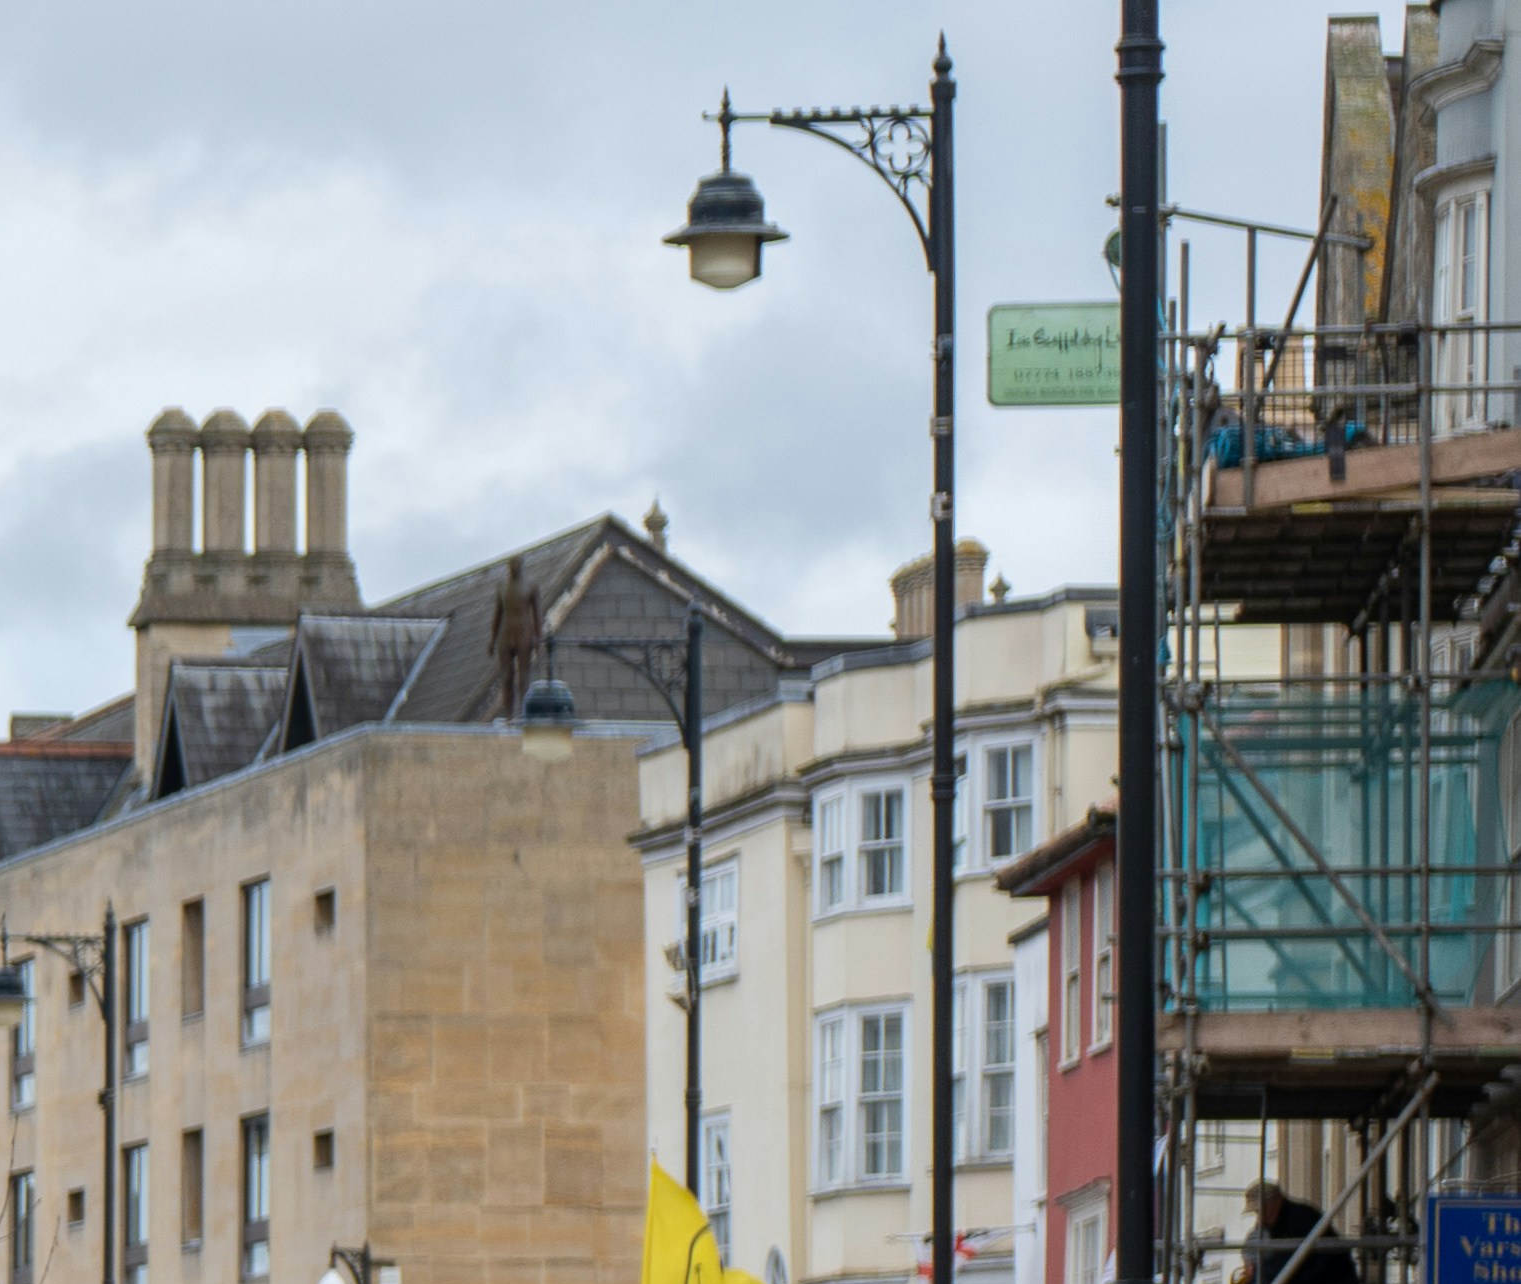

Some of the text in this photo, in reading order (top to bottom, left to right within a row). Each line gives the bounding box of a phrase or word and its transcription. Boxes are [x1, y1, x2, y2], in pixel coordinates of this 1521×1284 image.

[1482, 1212, 1521, 1234] Th
[1460, 1236, 1521, 1258] Vars
[1474, 1260, 1521, 1283] Sho
